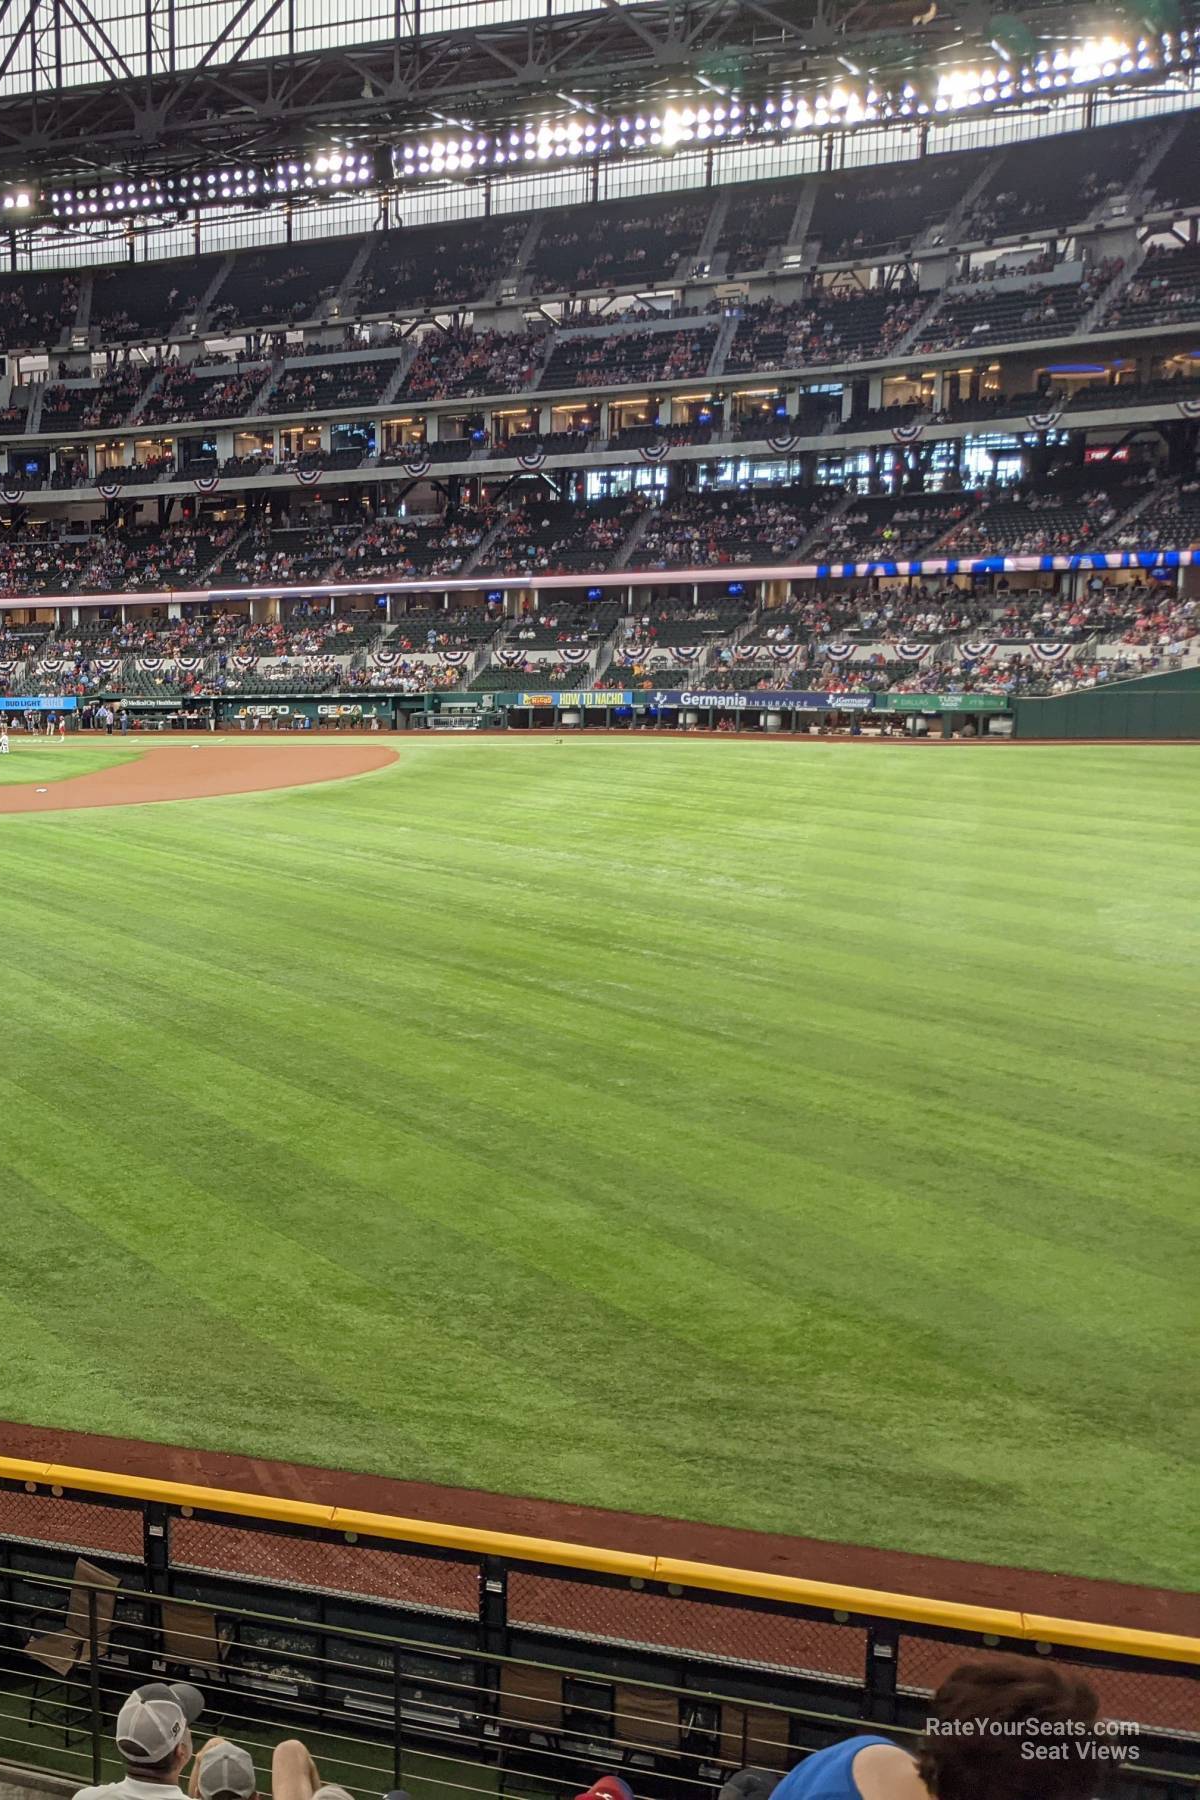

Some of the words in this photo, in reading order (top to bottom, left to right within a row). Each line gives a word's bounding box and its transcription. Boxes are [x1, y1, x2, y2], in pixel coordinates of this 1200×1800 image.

[560, 692, 580, 704] HOW
[583, 692, 593, 704] TO
[680, 692, 747, 706] Germania
